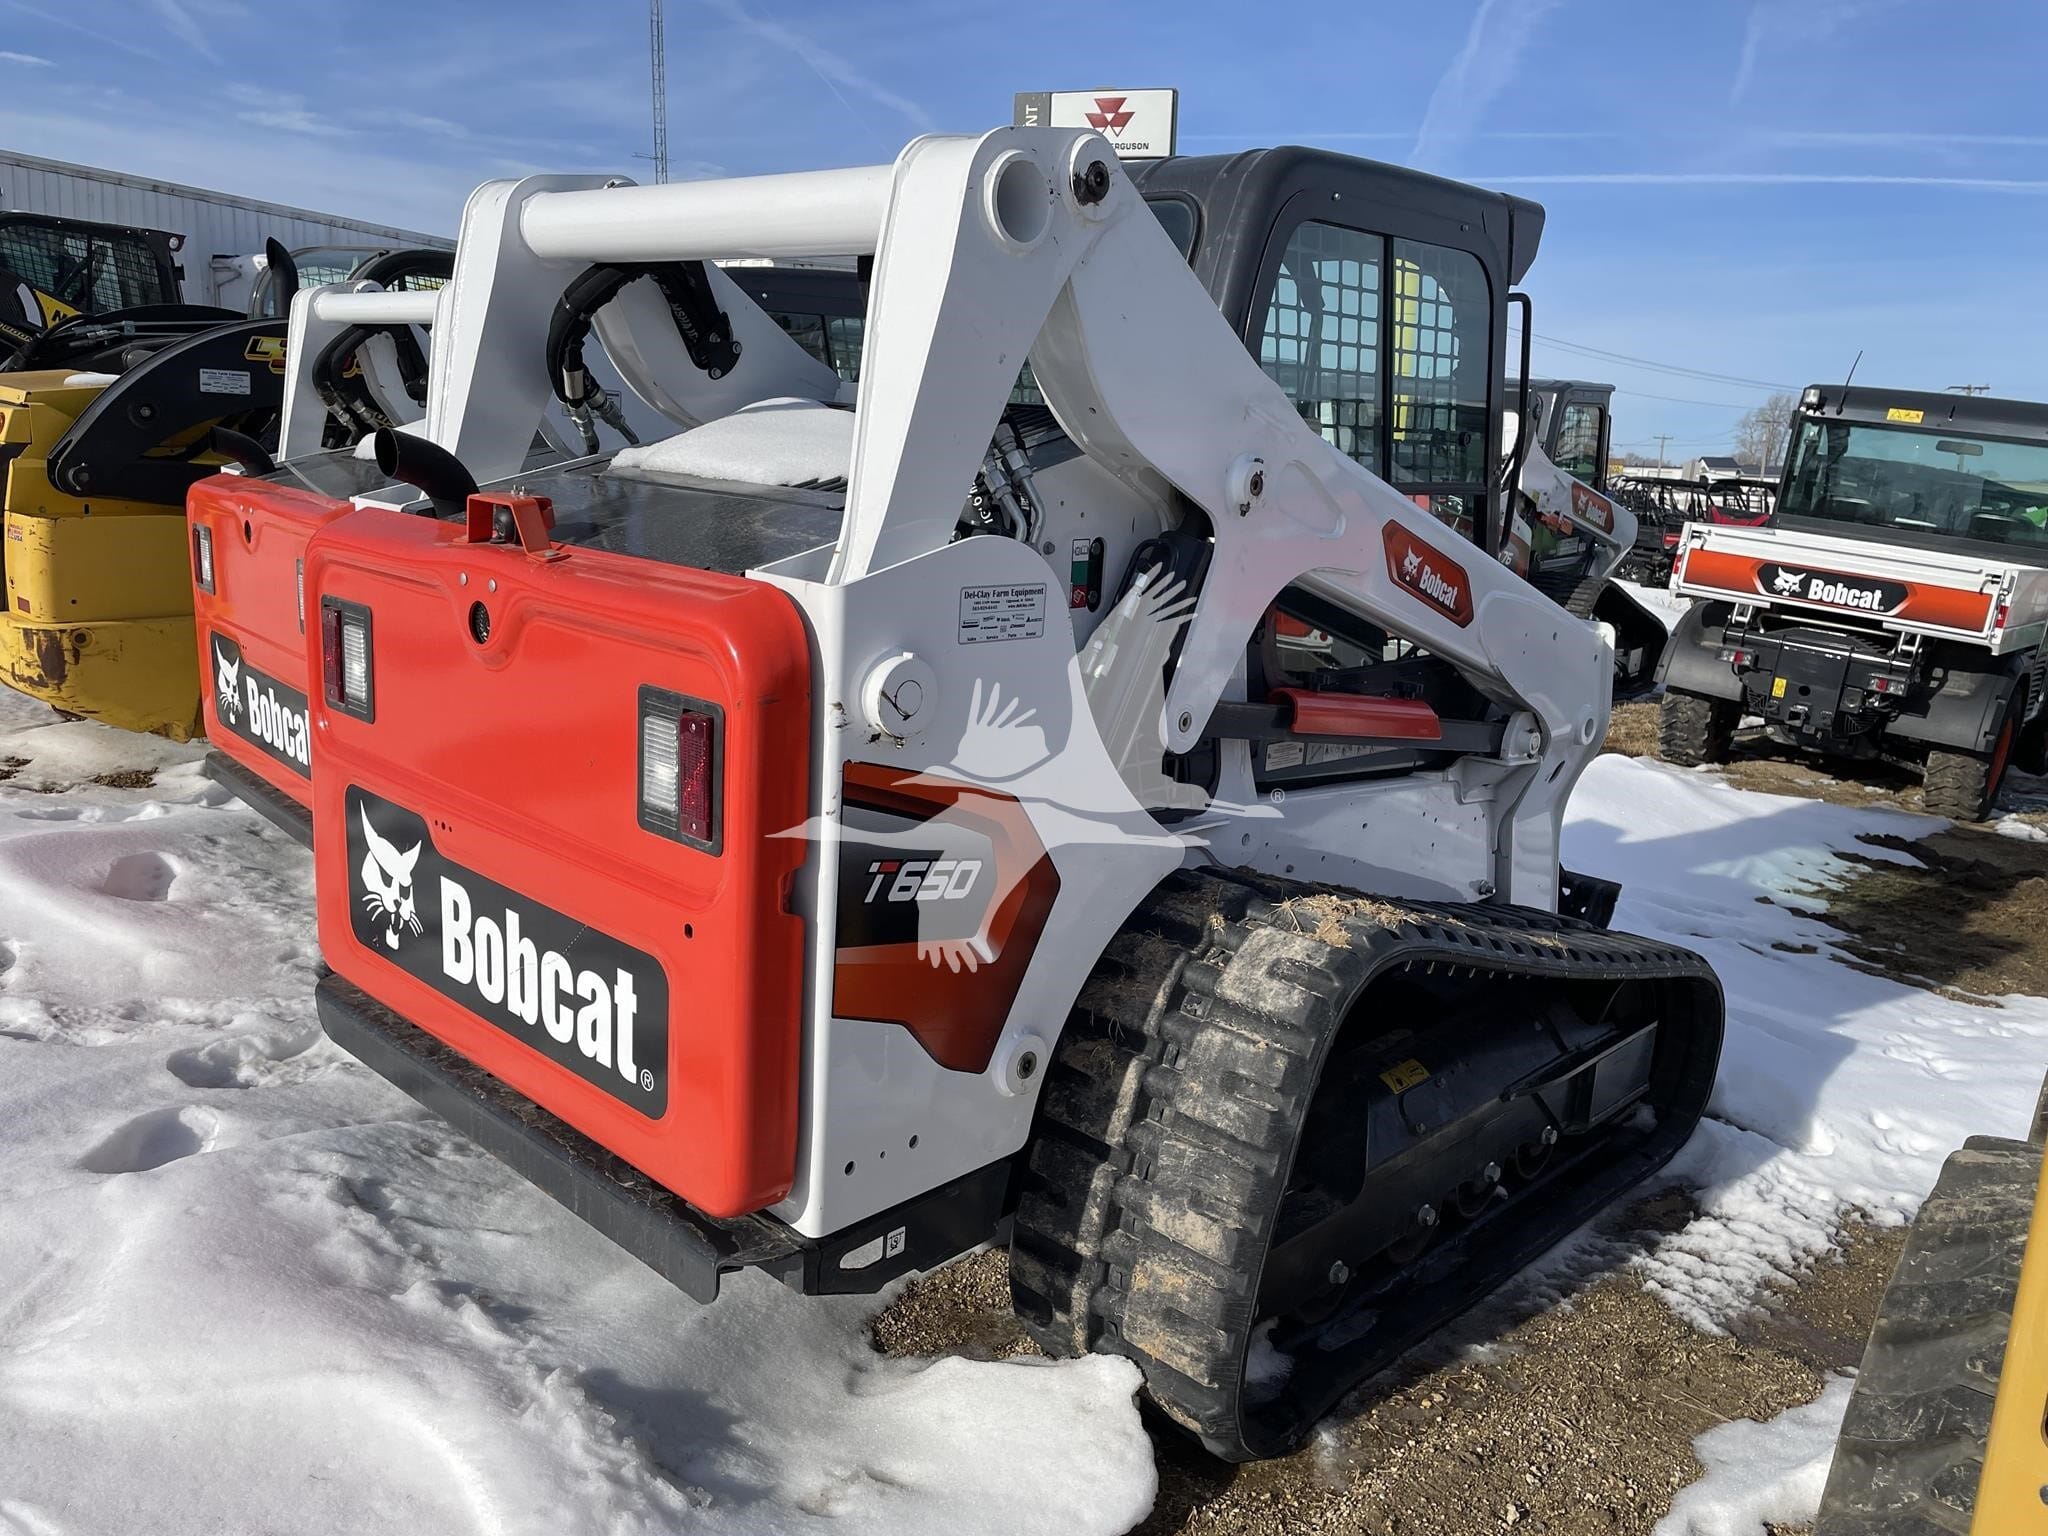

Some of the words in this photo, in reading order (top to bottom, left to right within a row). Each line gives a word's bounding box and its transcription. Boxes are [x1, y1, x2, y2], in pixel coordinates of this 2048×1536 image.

[992, 589, 1010, 598] Farm
[1011, 587, 1044, 598] Equipment
[1419, 564, 1458, 609] Bobcat
[1807, 578, 1882, 610] Bobcat
[864, 860, 982, 903] T650
[440, 875, 638, 1085] Bobcat
